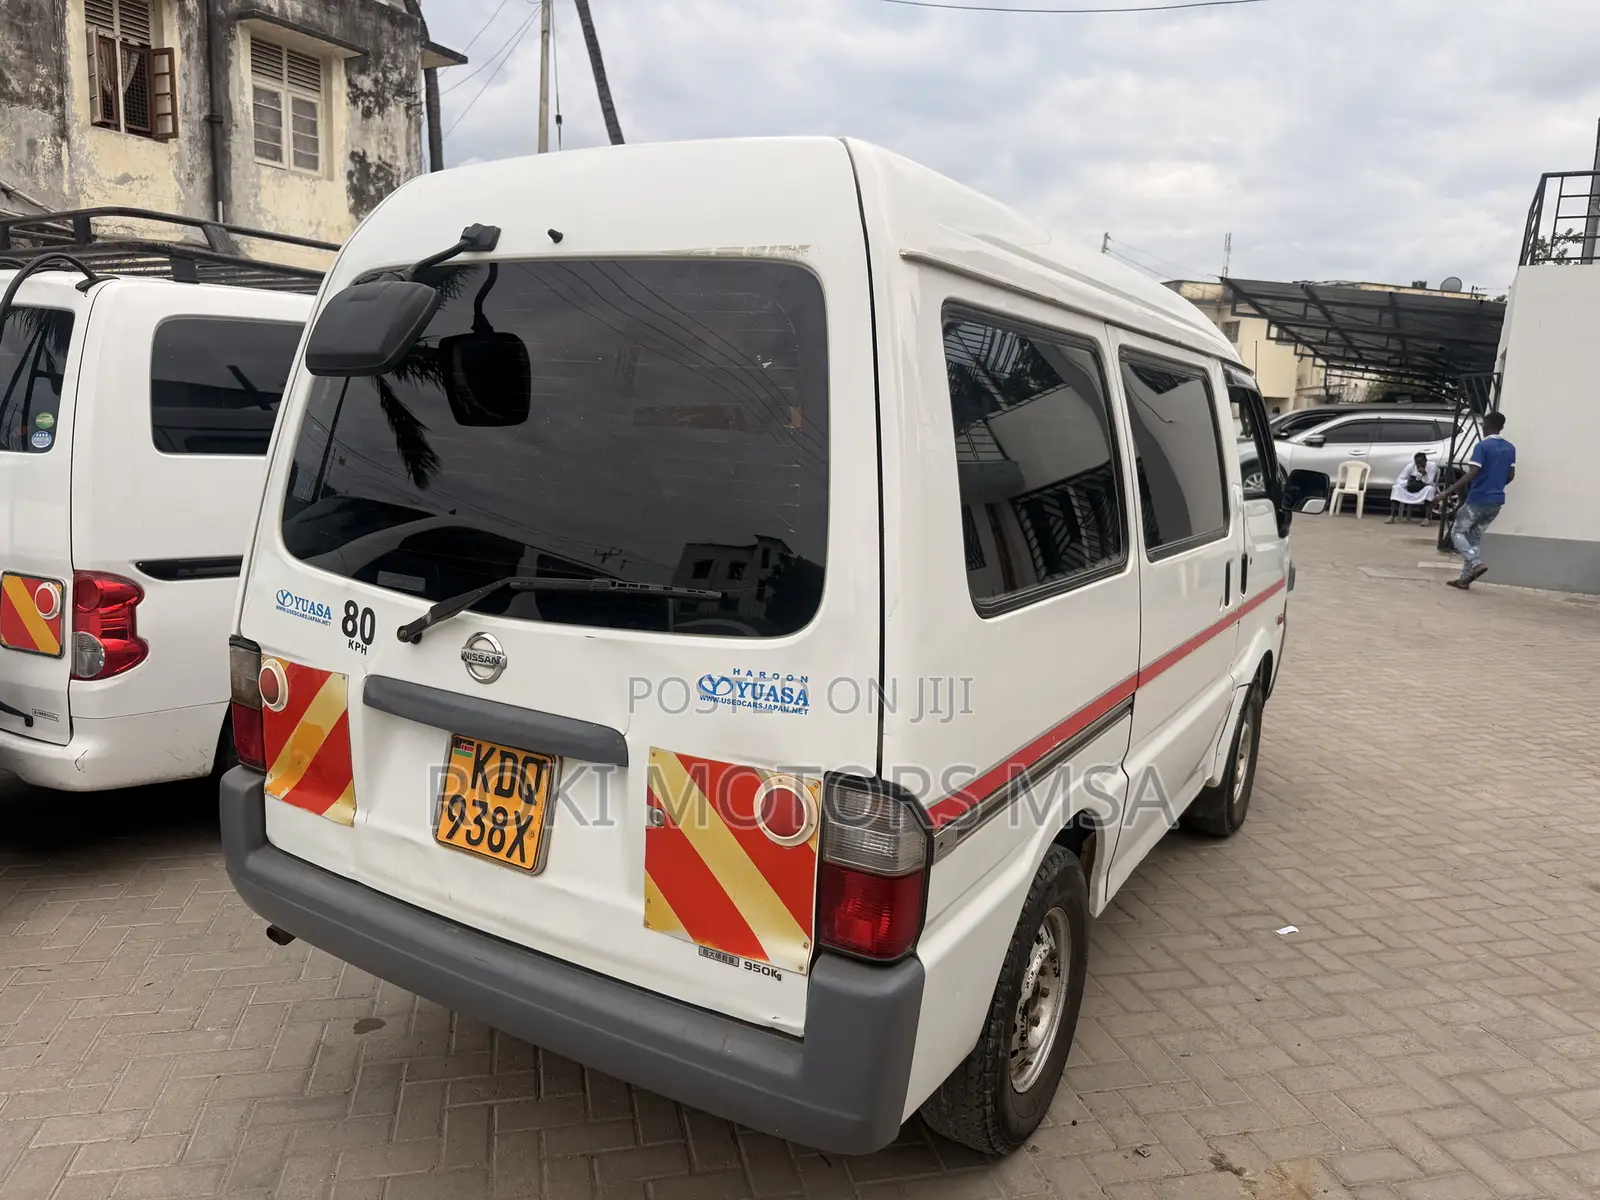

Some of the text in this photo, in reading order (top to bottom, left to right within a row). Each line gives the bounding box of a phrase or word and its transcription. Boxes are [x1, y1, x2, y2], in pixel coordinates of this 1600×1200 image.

[294, 596, 332, 620] YUASA
[342, 600, 376, 646] 80
[348, 639, 368, 655] KPH
[462, 651, 502, 666] NISSAN
[732, 668, 809, 683] HAROON
[699, 694, 809, 715] WWW.USEDCARSJAPAN.NET
[735, 681, 809, 706] YUASA
[471, 743, 547, 806] KDQ
[446, 794, 534, 863] 938X
